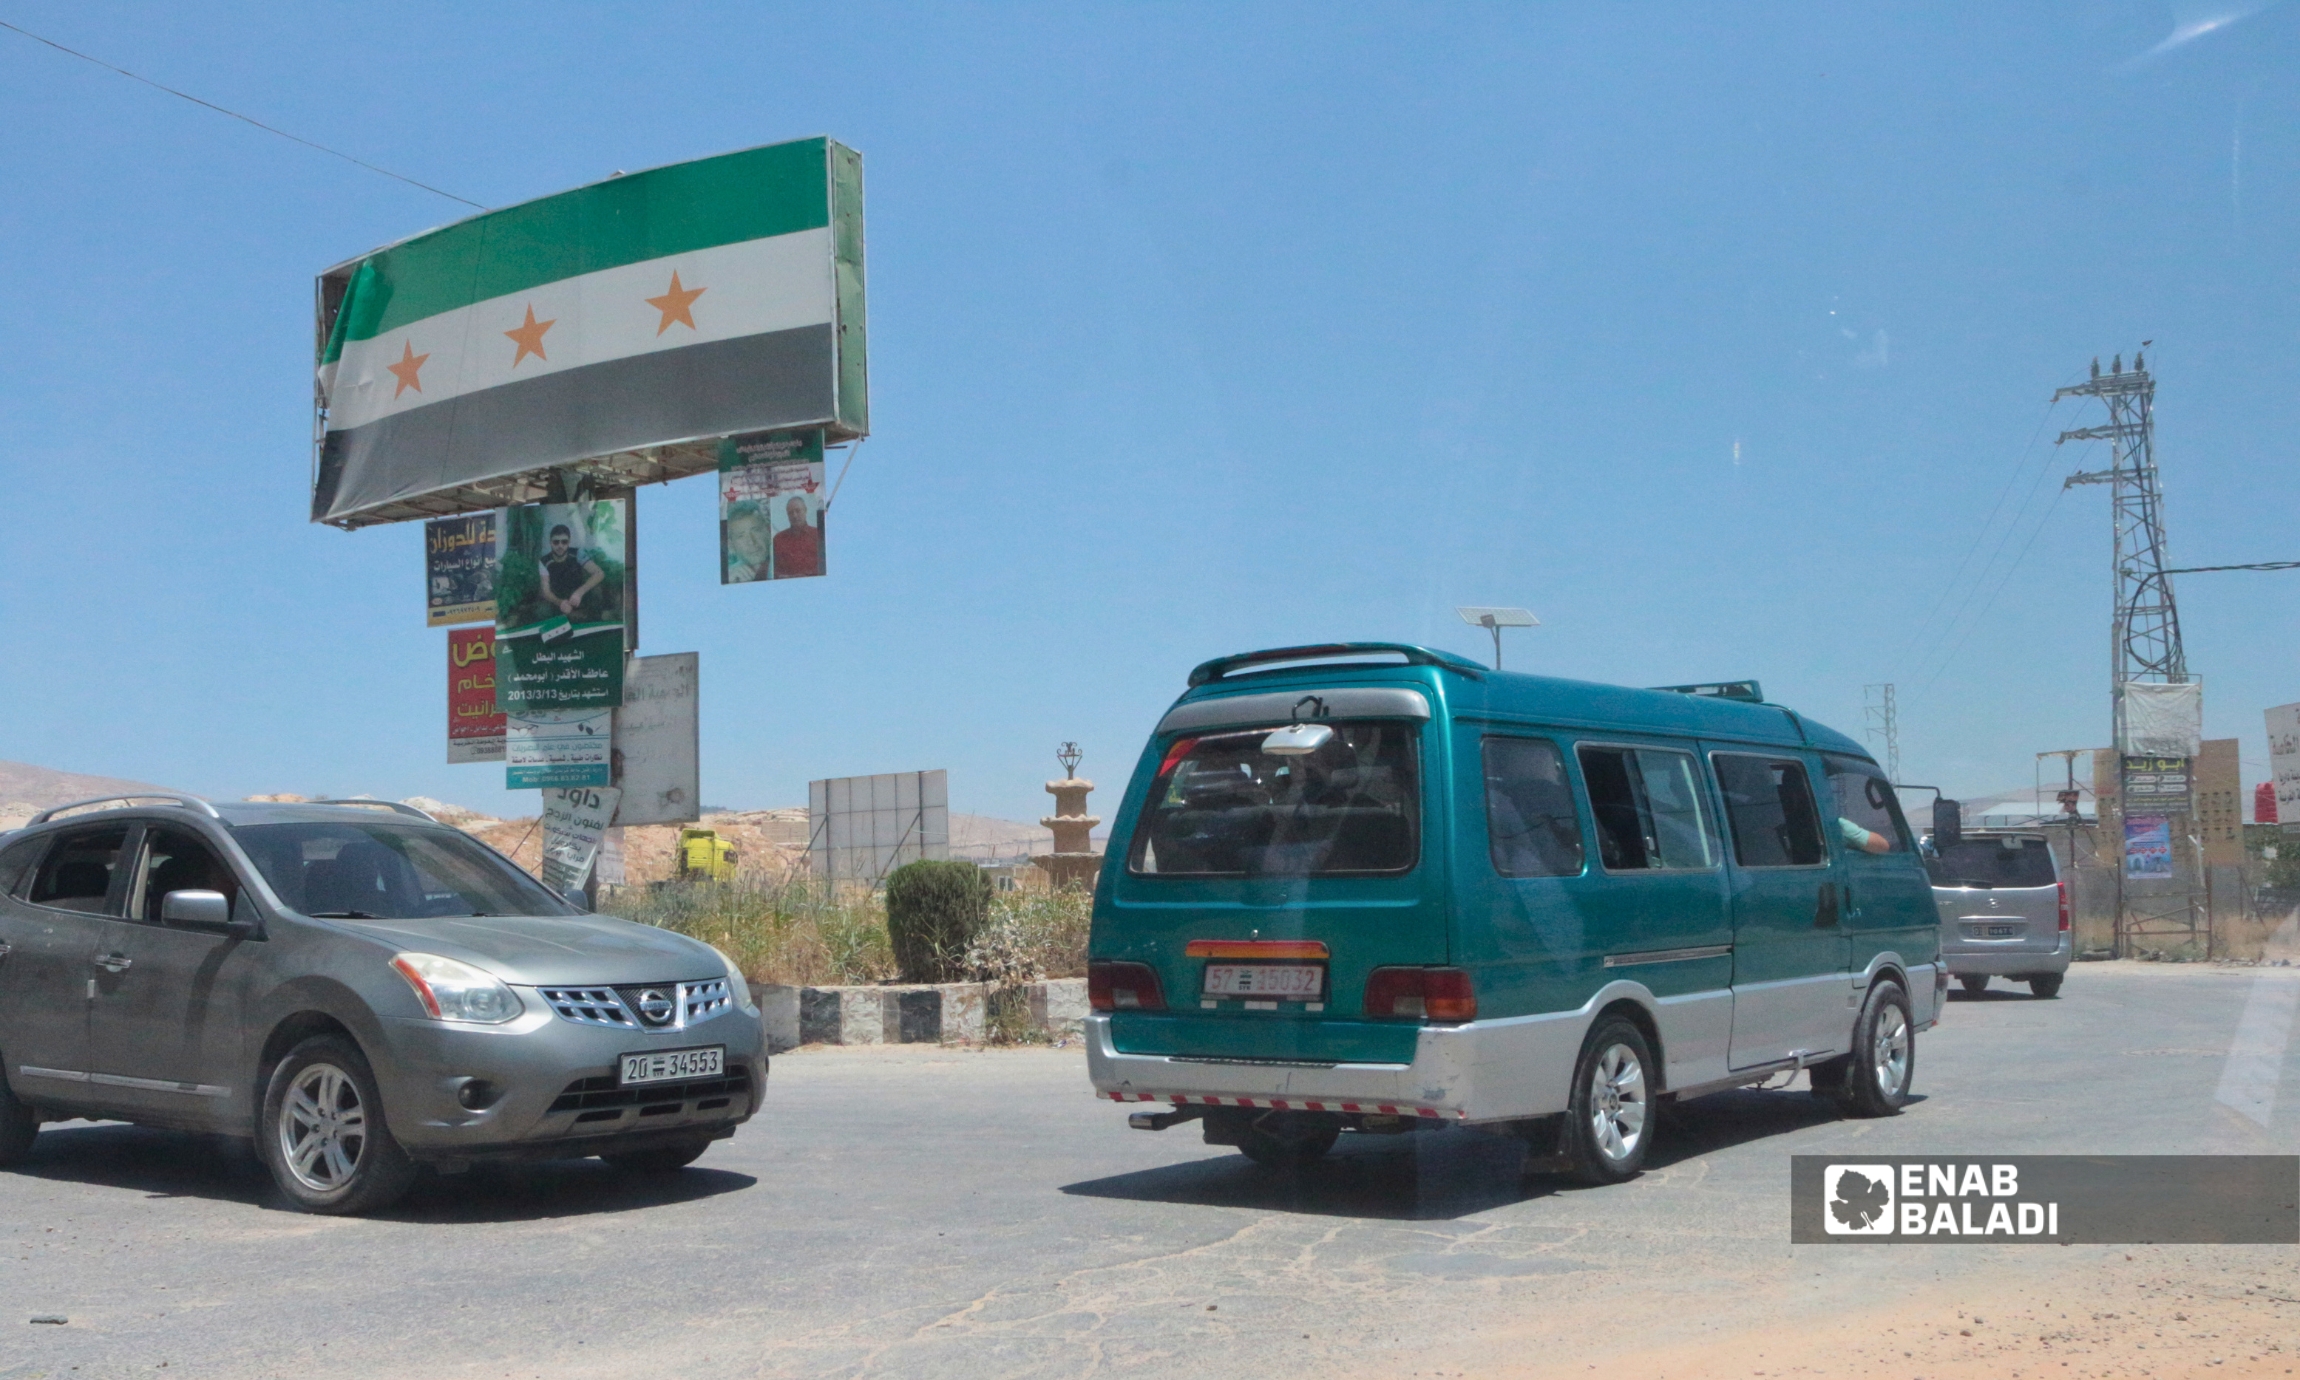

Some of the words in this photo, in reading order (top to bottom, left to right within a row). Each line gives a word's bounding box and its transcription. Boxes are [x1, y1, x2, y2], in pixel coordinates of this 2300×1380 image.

[433, 558, 463, 573] السيارات
[532, 652, 556, 664] البطل
[557, 649, 585, 663] الشهيد
[458, 674, 496, 694] خام
[508, 689, 557, 701] 2013/3/13
[558, 690, 580, 701] بتاريخ
[581, 687, 609, 699] استشهد
[457, 700, 495, 719] رانيت
[558, 787, 600, 809] داود
[1211, 969, 1232, 990] 57
[628, 1058, 648, 1080] 20
[669, 1051, 718, 1076] 34553
